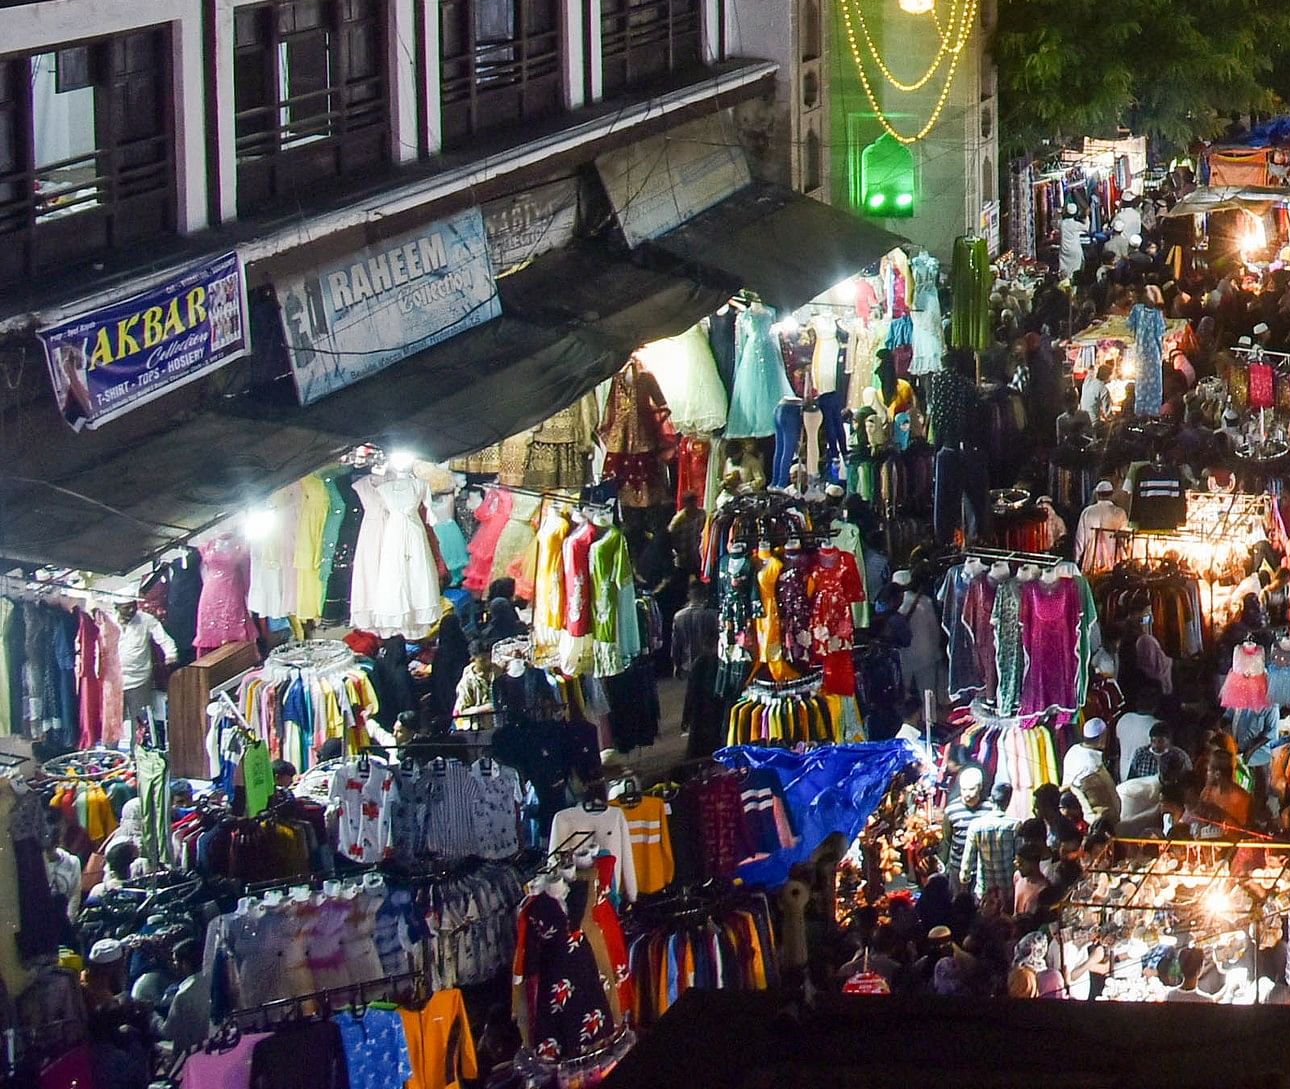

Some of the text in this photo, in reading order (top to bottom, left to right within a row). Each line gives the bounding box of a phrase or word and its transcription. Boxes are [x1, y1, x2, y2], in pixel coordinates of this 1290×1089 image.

[328, 233, 447, 311] RAHEEM
[87, 286, 208, 372] AKBAR
[146, 331, 209, 370] Collection
[97, 379, 130, 406] T-SHIRT
[137, 367, 161, 386] TOPS
[168, 346, 206, 375] HOSIERY
